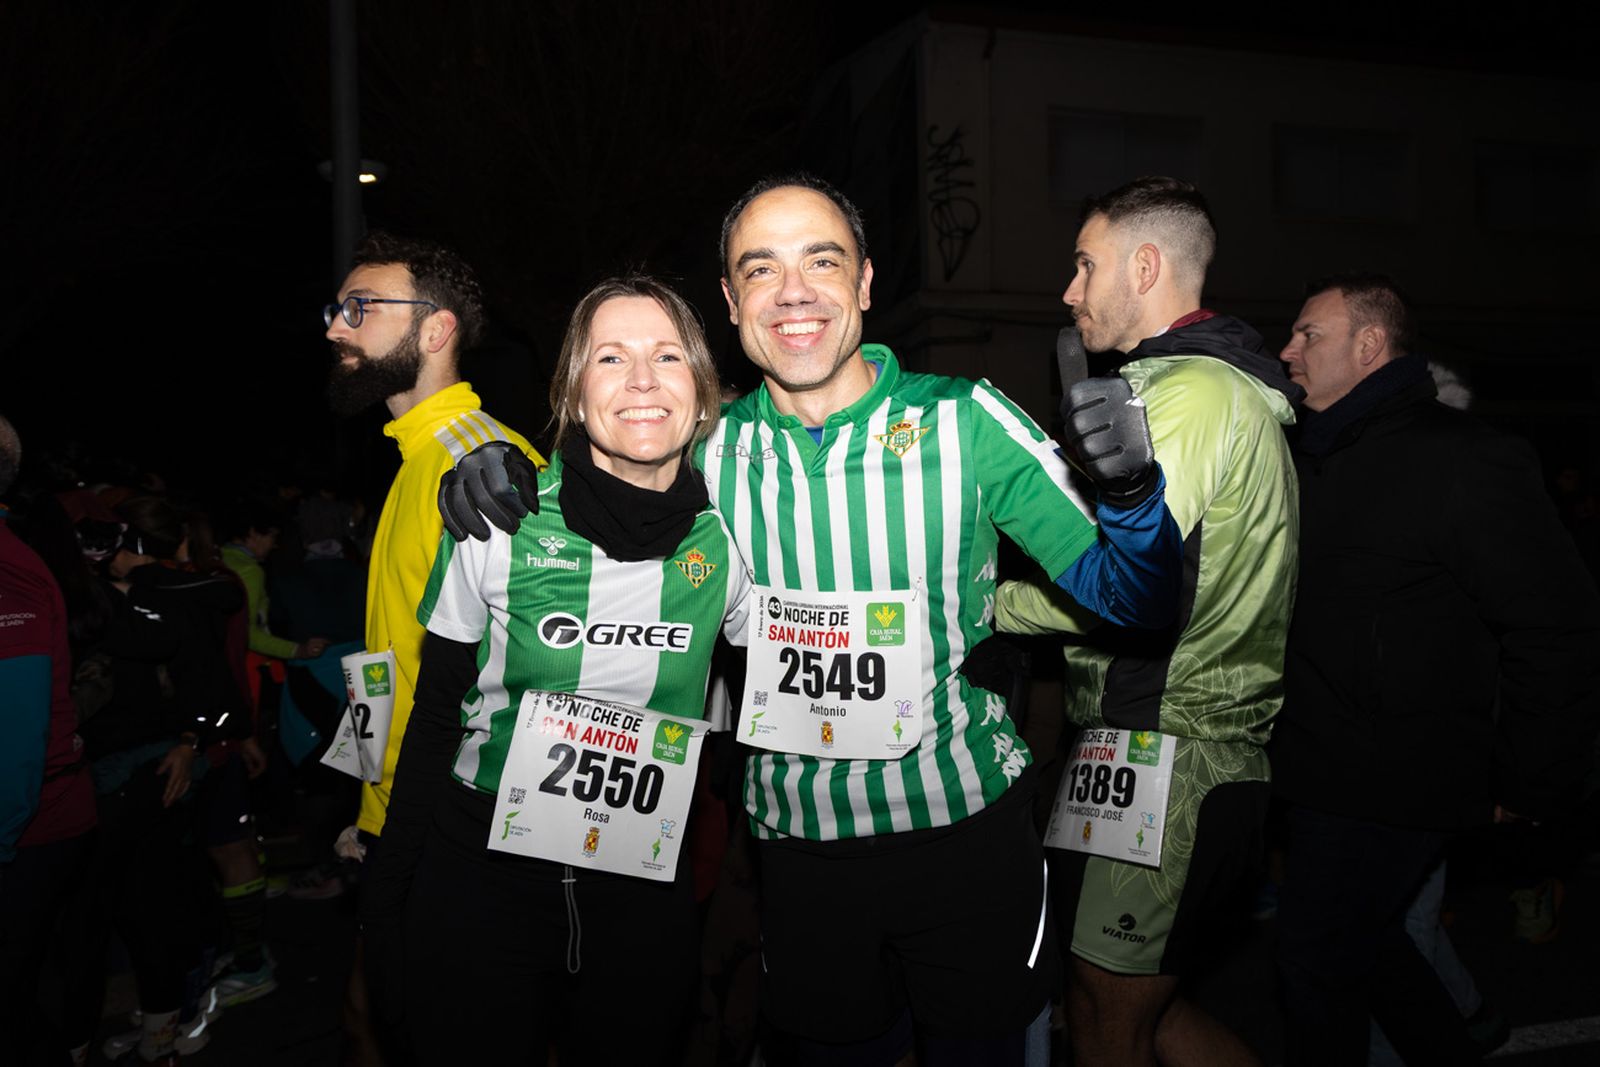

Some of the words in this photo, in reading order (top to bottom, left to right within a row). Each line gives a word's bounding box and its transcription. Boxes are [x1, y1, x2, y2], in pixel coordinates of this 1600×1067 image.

[527, 553, 580, 571] hummel
[768, 601, 781, 613] 43
[784, 607, 825, 626] NOCHE
[829, 611, 850, 626] DE
[586, 622, 690, 649] GREE
[768, 624, 795, 644] SAN
[798, 627, 850, 649] ANTÓN
[778, 647, 886, 701] 2549
[567, 700, 622, 727] NOCHE
[622, 714, 643, 733] DE
[810, 702, 847, 717] Antonio
[580, 725, 639, 755] ANTÓN
[1105, 731, 1120, 744] DE
[1082, 744, 1117, 762] ANTÓN
[538, 742, 665, 815] 2550
[1068, 763, 1137, 808] 1389
[583, 807, 610, 824] Rosa
[1066, 805, 1100, 818] FRANCISCO
[1101, 810, 1125, 822] JOSÉ
[1102, 926, 1147, 943] VIATOR
